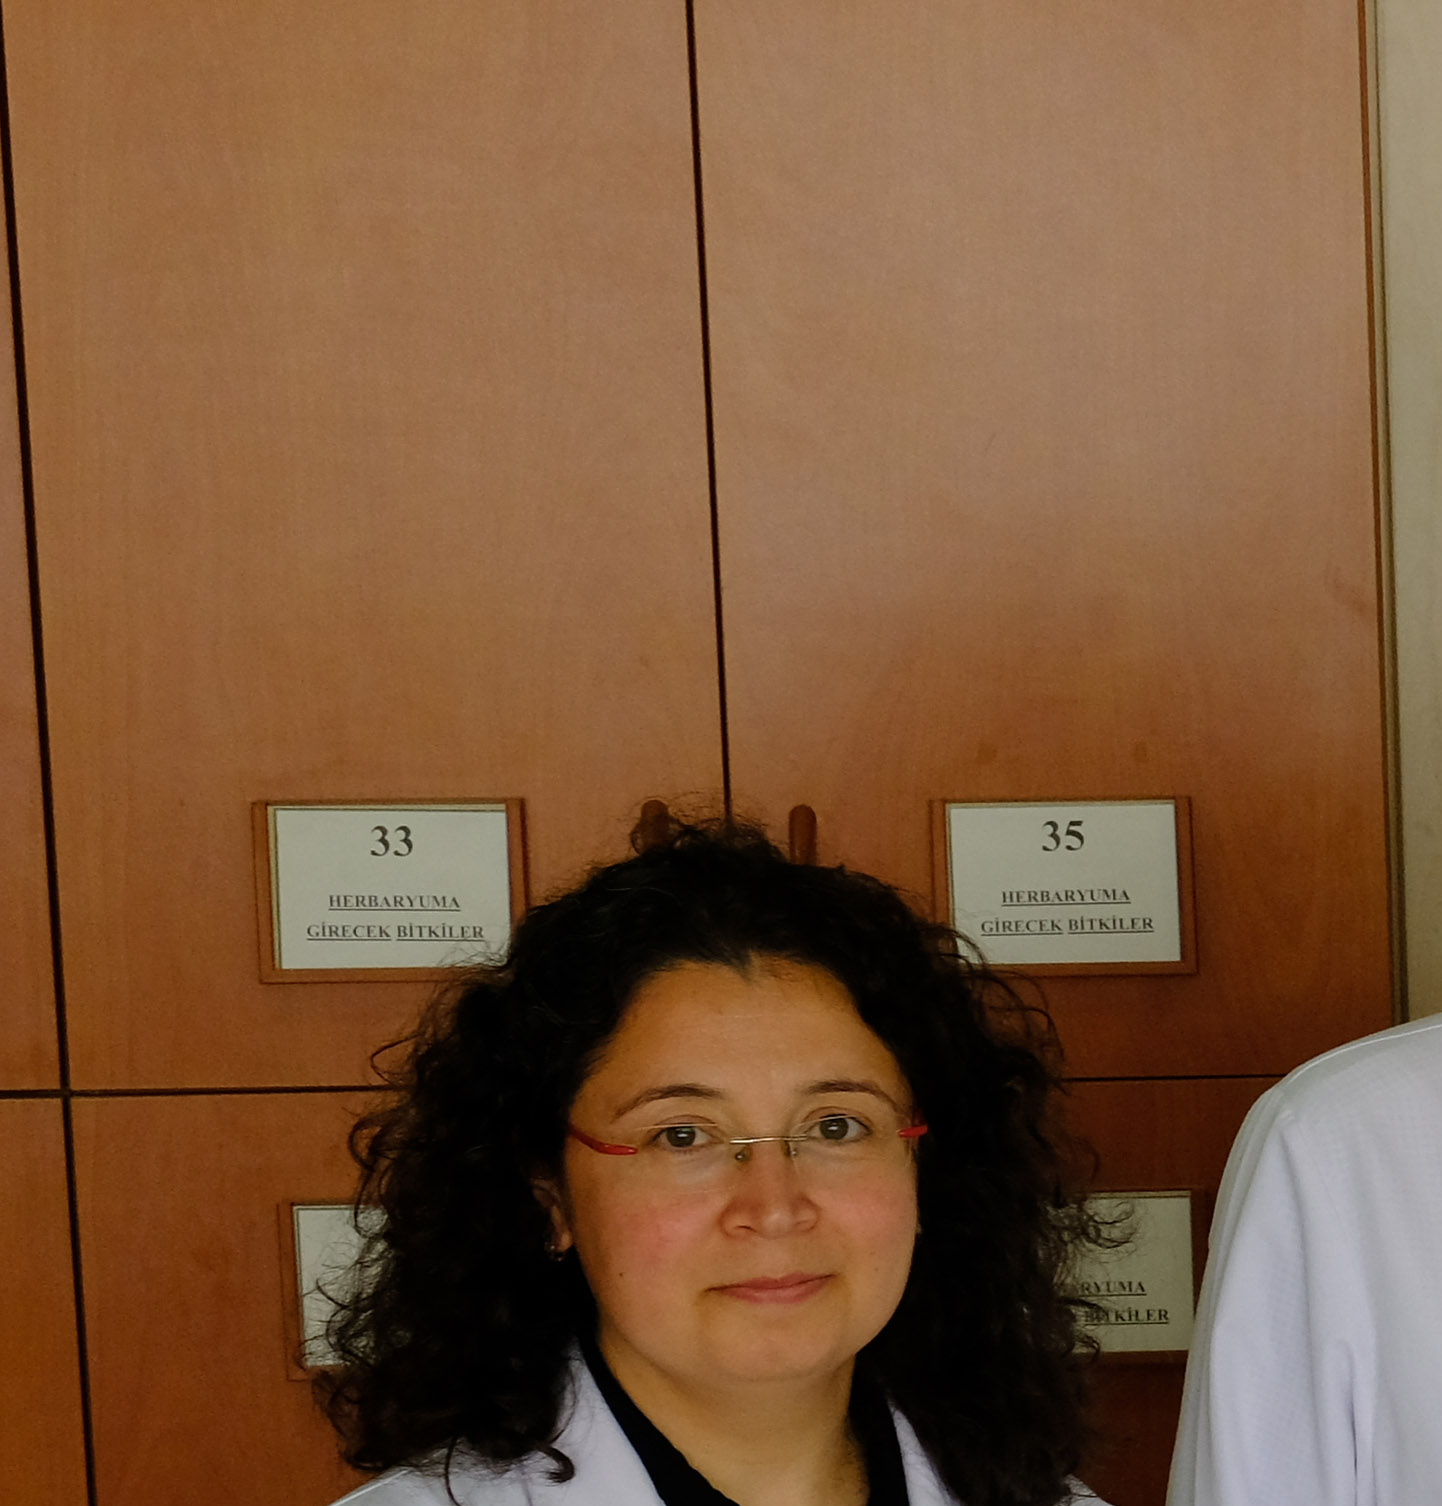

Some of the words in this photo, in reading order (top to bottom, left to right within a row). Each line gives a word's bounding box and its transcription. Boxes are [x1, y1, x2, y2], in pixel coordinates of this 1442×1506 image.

[370, 825, 414, 857] 33
[1042, 820, 1085, 852] 35
[329, 895, 461, 910] HERBARYUMA
[1002, 889, 1131, 904] HERBARYUMA
[307, 921, 391, 938] GİRECEK
[397, 922, 484, 939] BİTKİLER
[981, 917, 1062, 933] GİRECEK
[1069, 916, 1154, 932] BİTKİLER
